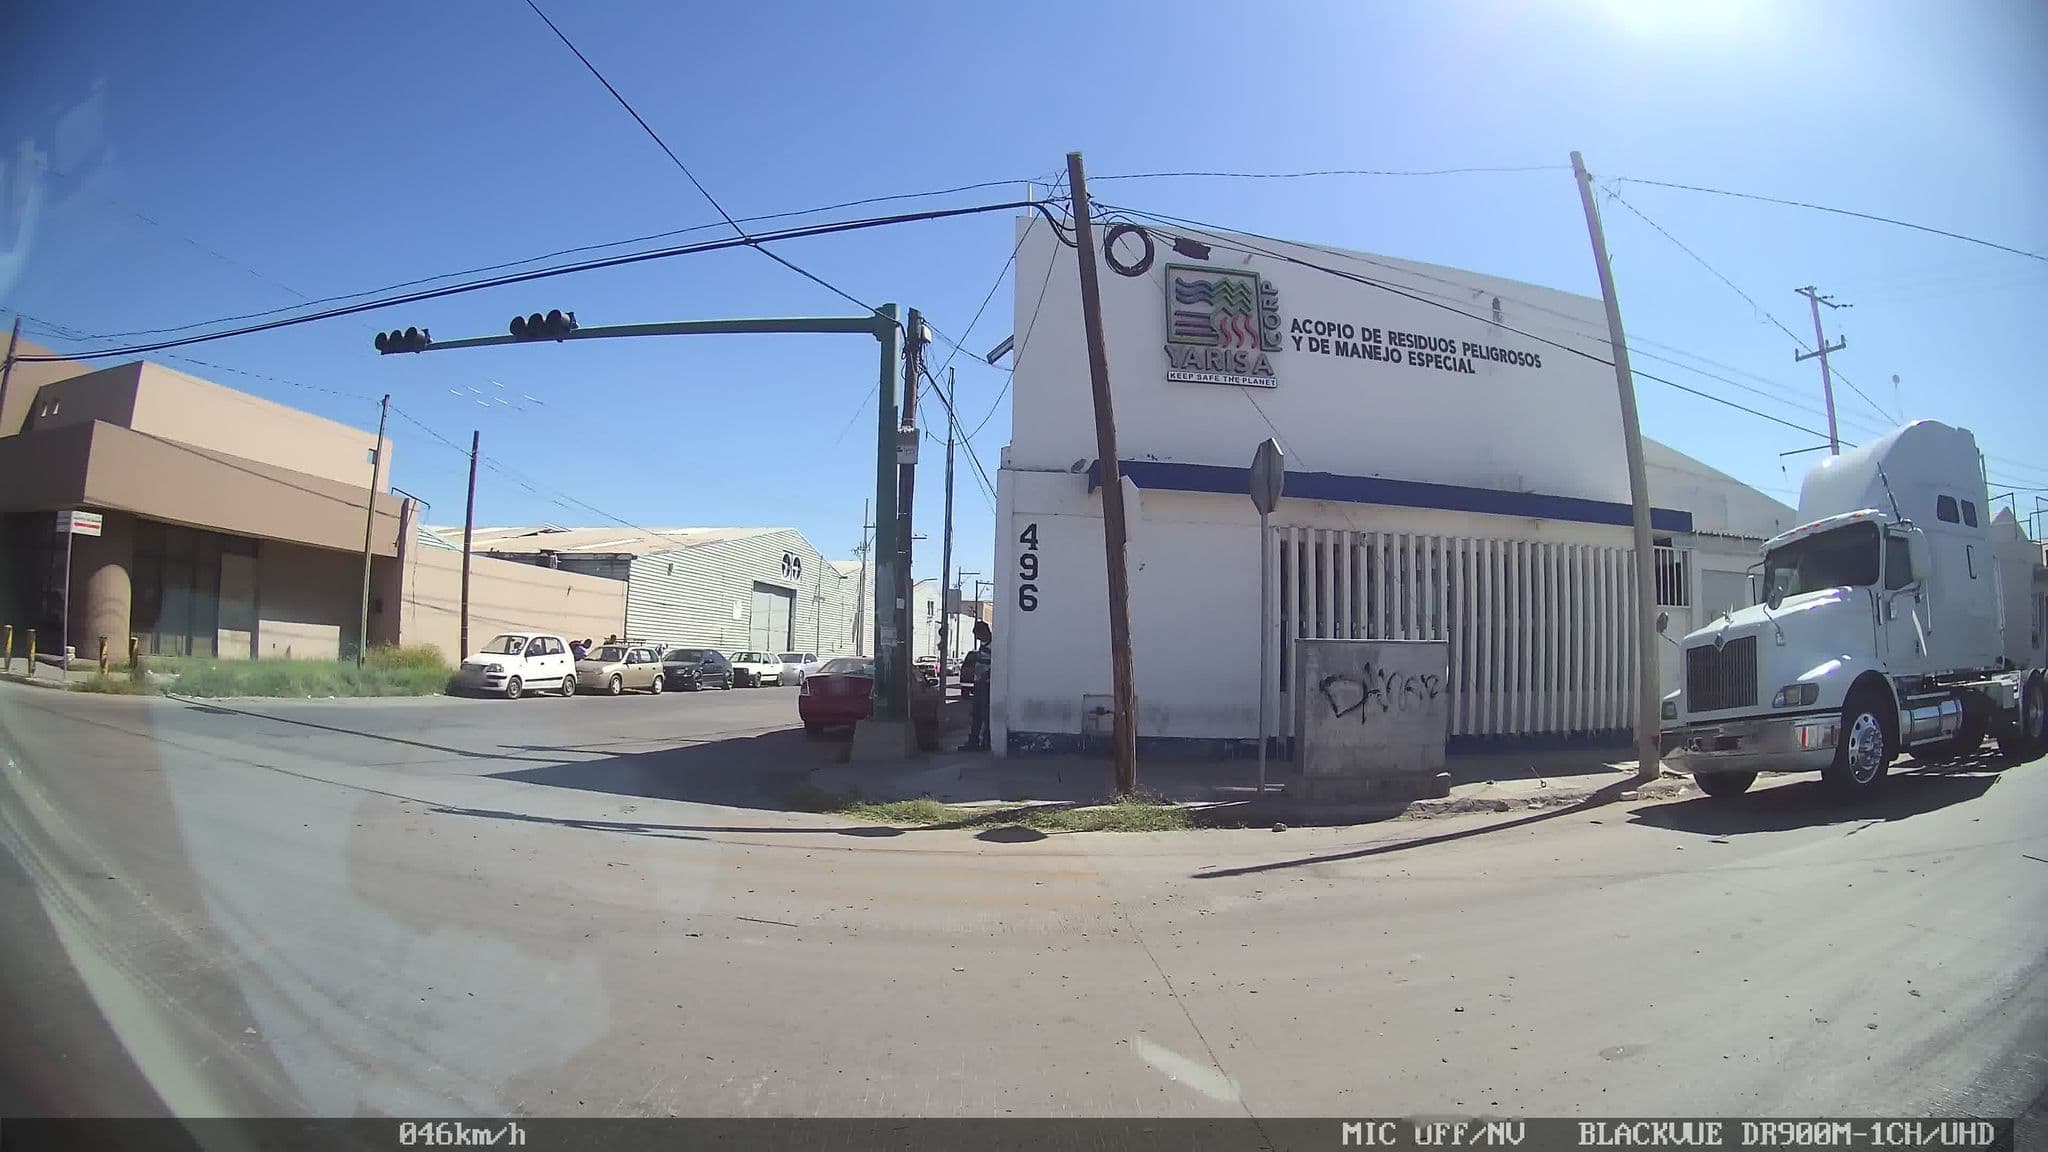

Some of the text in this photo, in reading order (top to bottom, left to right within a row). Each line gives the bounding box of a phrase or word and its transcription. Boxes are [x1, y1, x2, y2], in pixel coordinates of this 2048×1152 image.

[1260, 280, 1282, 348] CORP
[1163, 344, 1275, 377] YARISA
[1290, 318, 1542, 369] ACOPIO DE RESIDUOS PELIGROSOS
[1291, 335, 1476, 374] Y DE MANEJO ESPECIAL
[1169, 371, 1276, 387] KEEP SAFE THE PLANET
[1019, 523, 1039, 612] 496
